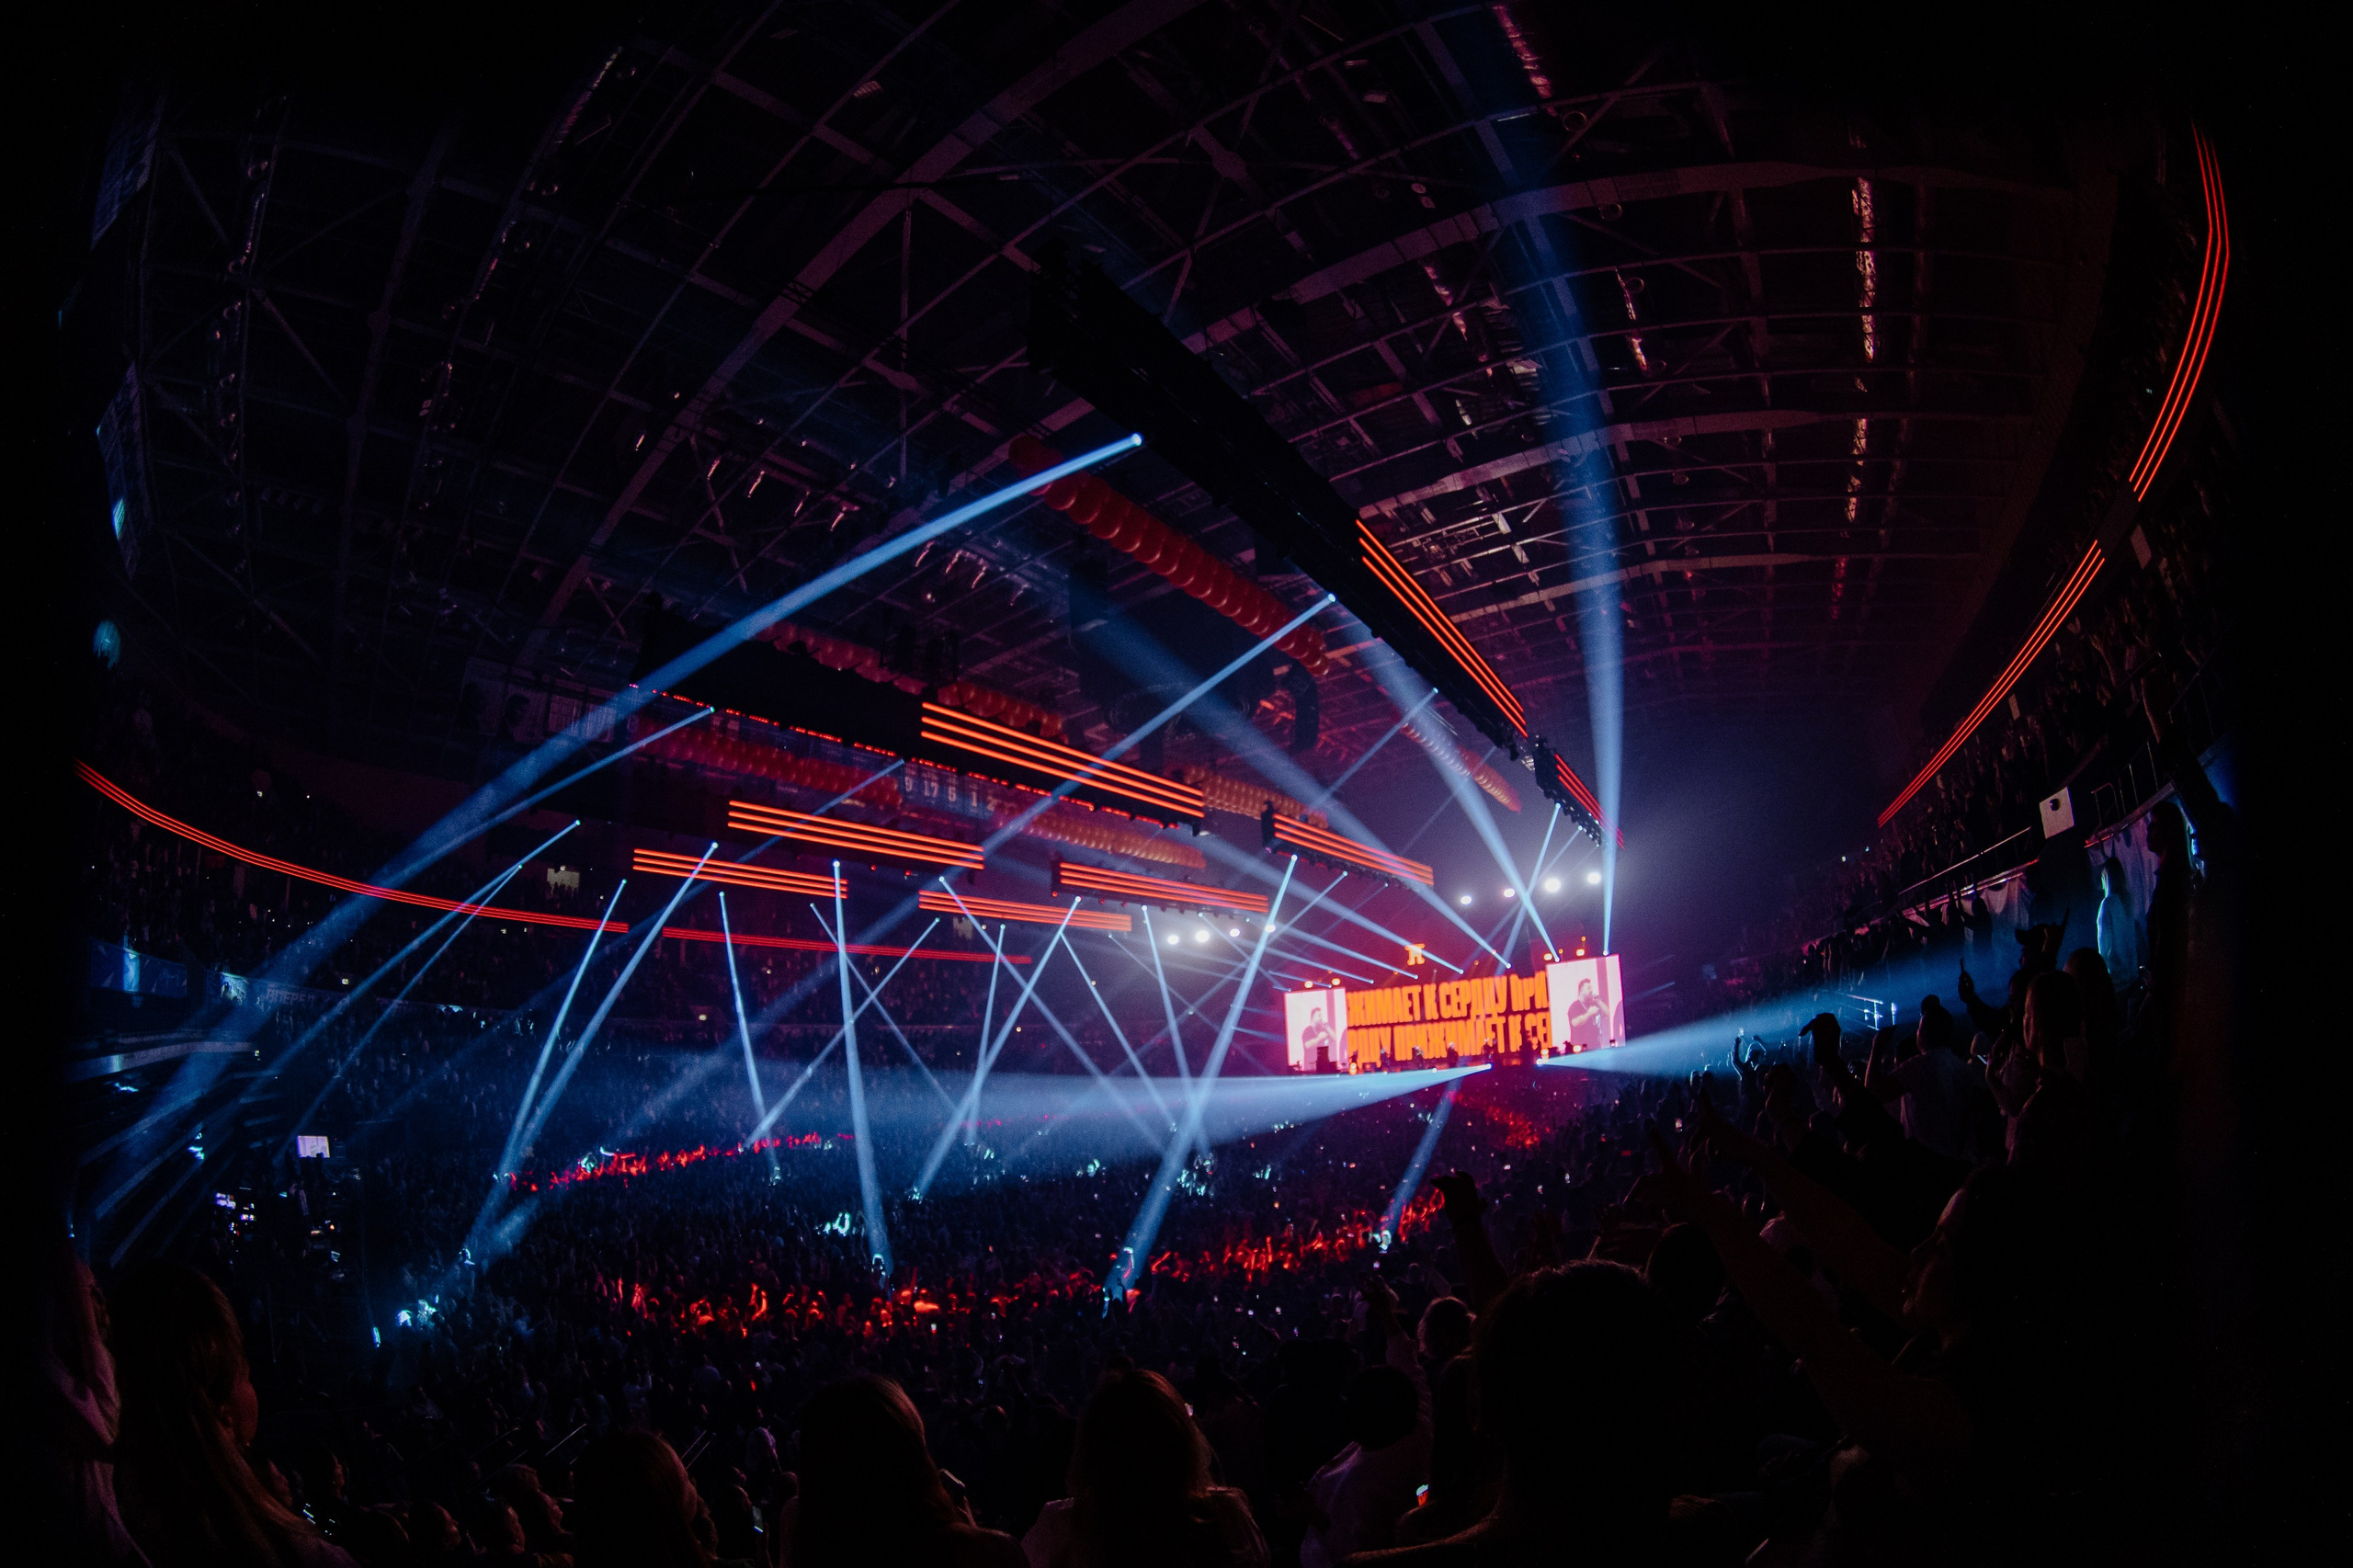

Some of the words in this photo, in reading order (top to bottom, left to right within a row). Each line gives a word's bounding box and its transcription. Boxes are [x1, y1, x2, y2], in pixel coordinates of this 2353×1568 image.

[924, 780, 938, 798] 17
[1423, 983, 1439, 1020] К
[1438, 975, 1507, 1020] СЕРДЦУ
